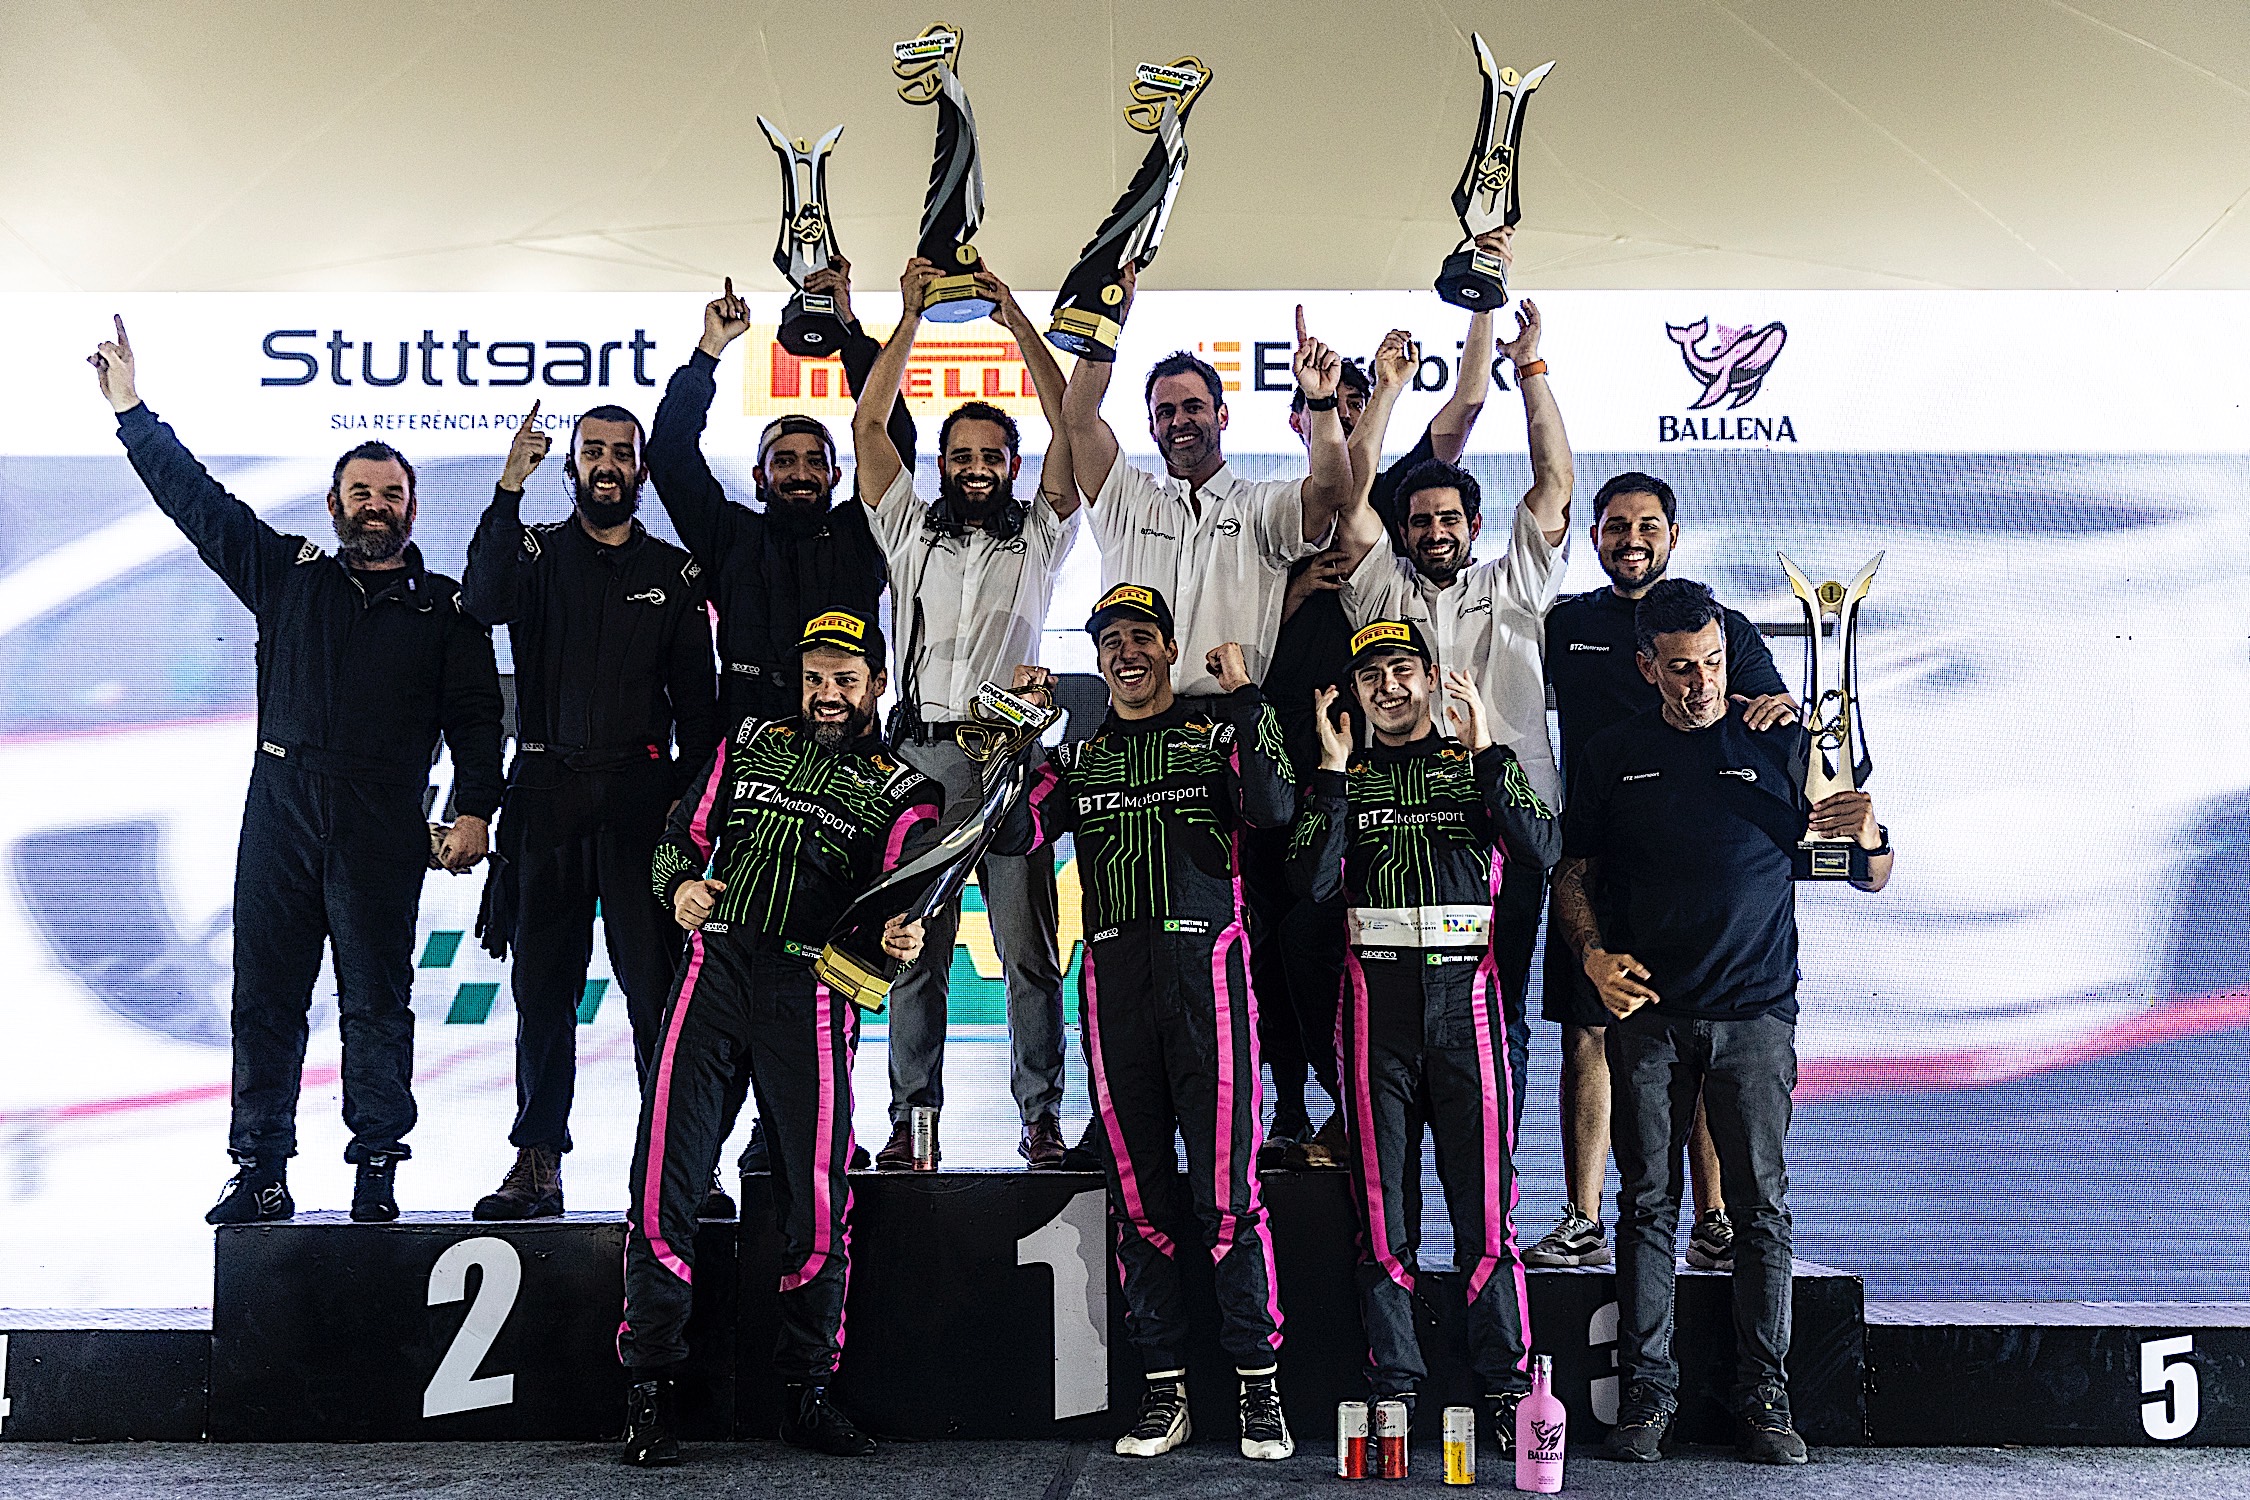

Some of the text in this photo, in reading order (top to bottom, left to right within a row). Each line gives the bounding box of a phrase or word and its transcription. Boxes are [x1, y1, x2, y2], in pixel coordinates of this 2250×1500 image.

[260, 329, 657, 388] Stuttgart
[770, 342, 1038, 398] PIELLI
[331, 414, 368, 430] SUA
[373, 409, 490, 430] REFERÊNCIA
[1658, 415, 1798, 443] BALLENA
[808, 615, 860, 633] PIRELLI
[1355, 625, 1404, 648] PIRELLI
[731, 662, 760, 675] sparco
[980, 683, 1038, 722] ENDURANCE
[891, 773, 927, 799] sparco
[1078, 785, 1209, 815] BTZ Motorsport
[734, 781, 858, 840] BTZ Motorsport
[1358, 808, 1395, 830] BTZ
[1361, 950, 1398, 961] sparco
[1017, 1188, 1109, 1421] 1
[422, 1236, 523, 1418] 2
[2140, 1334, 2200, 1441] 5
